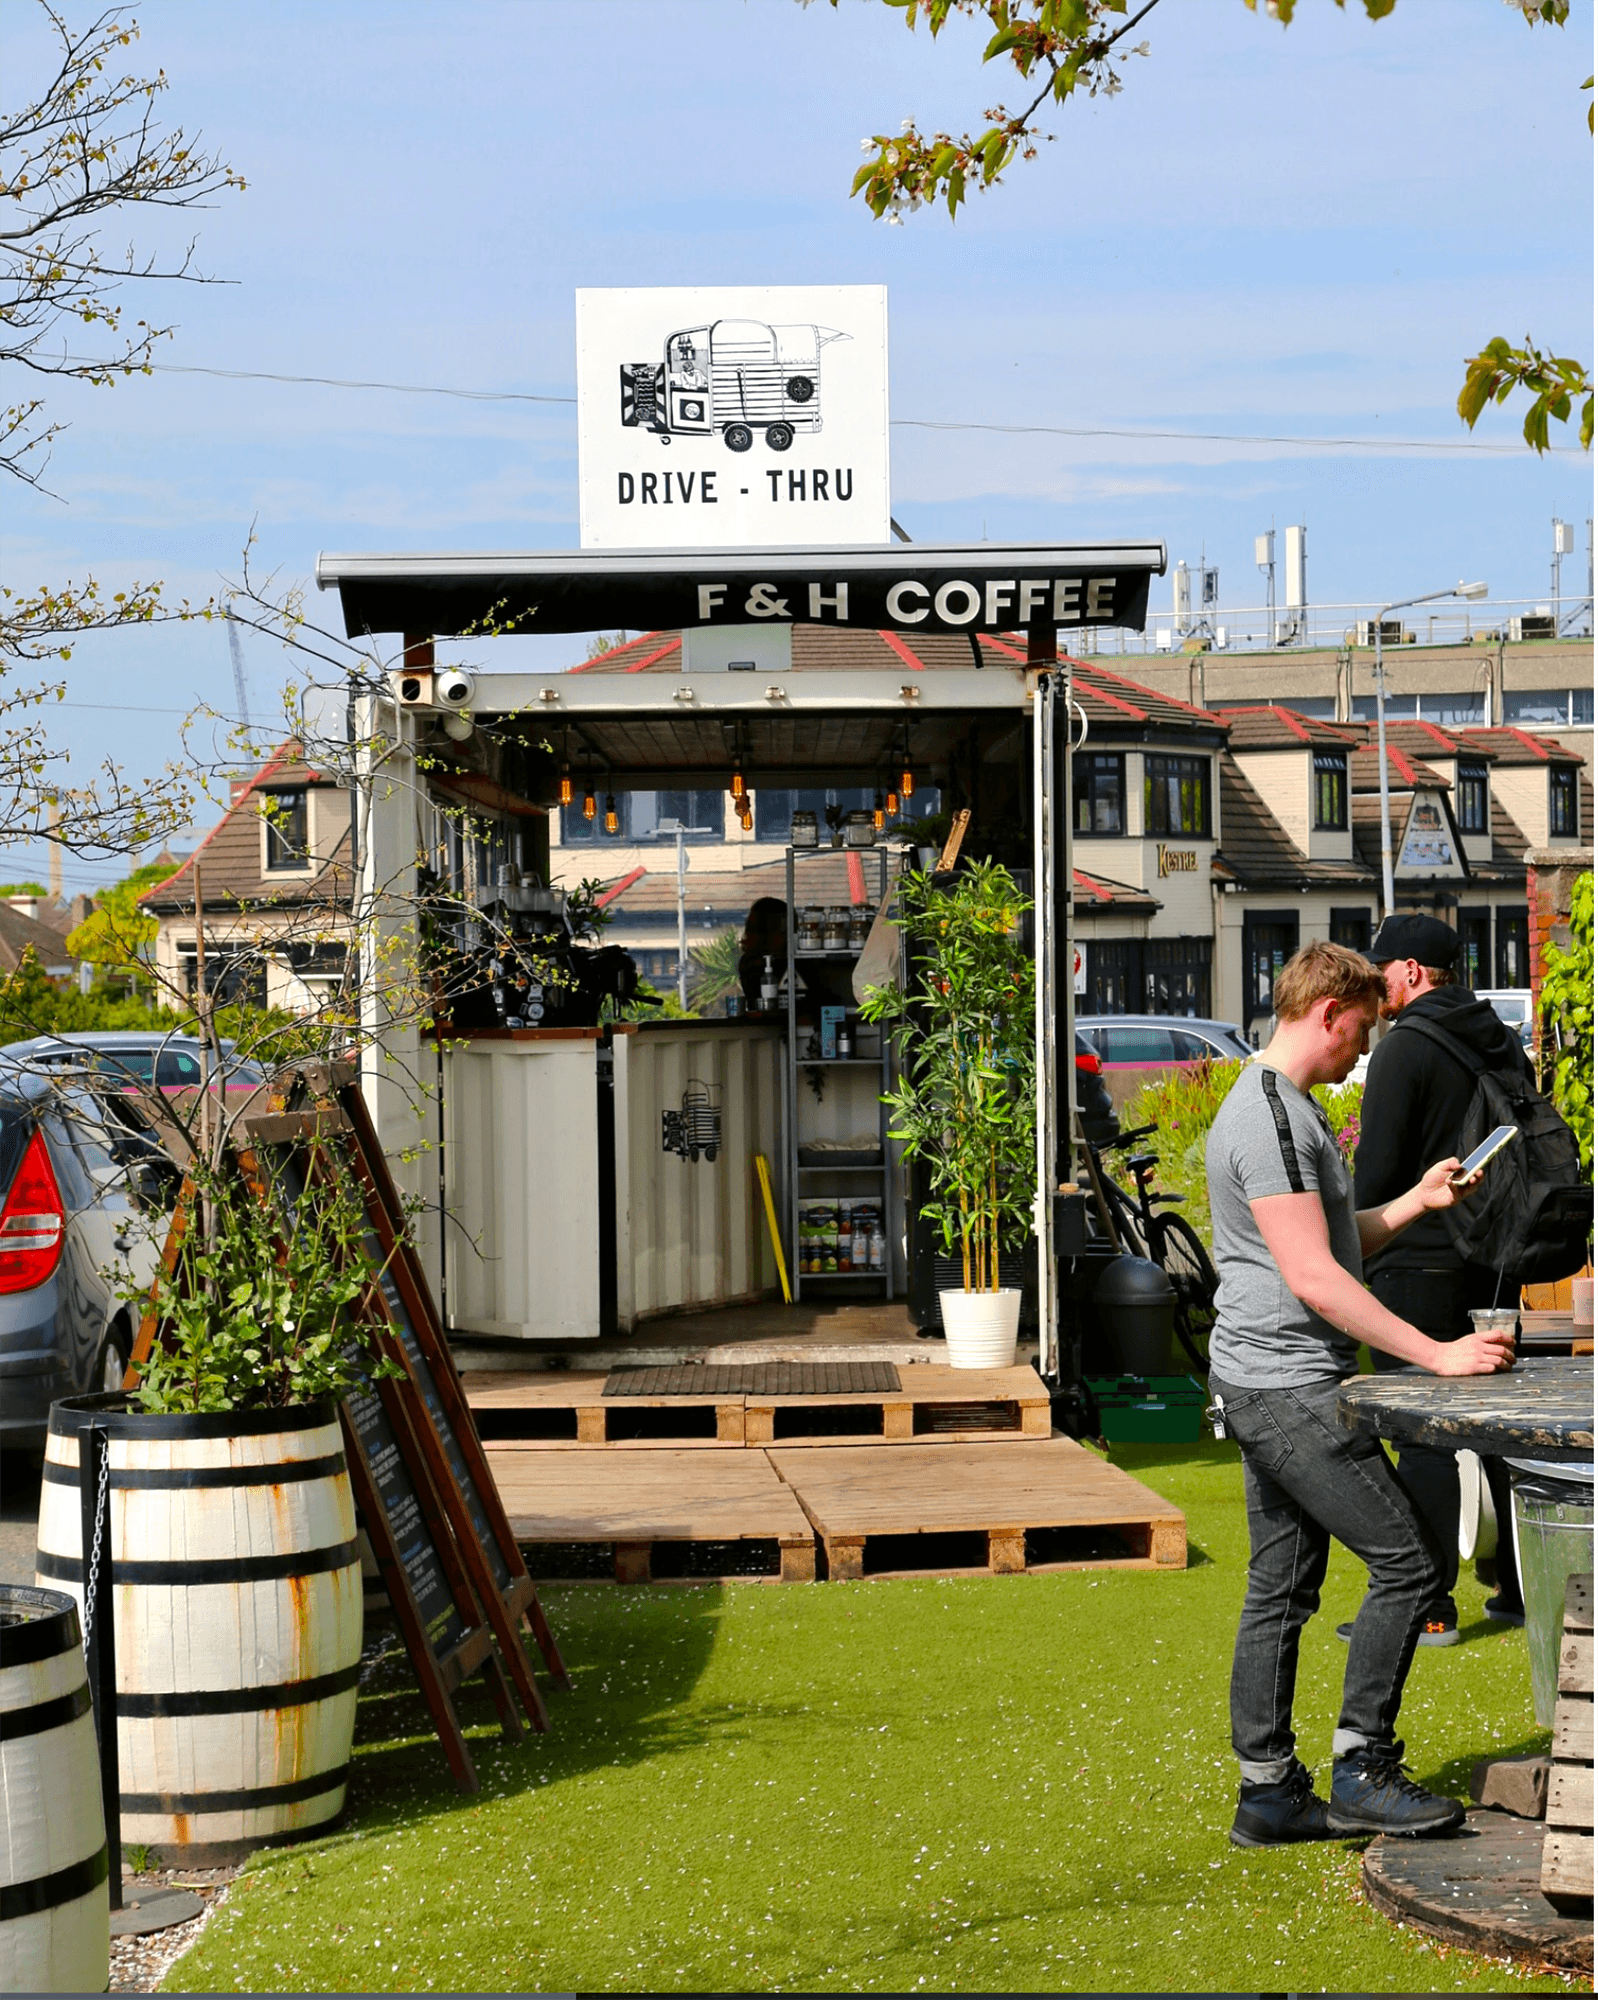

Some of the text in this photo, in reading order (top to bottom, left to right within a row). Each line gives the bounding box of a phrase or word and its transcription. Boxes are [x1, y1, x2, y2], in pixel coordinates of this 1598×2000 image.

[618, 470, 718, 504] DRIVE
[766, 468, 853, 502] THRU
[698, 578, 1116, 625] F & H COFFEE
